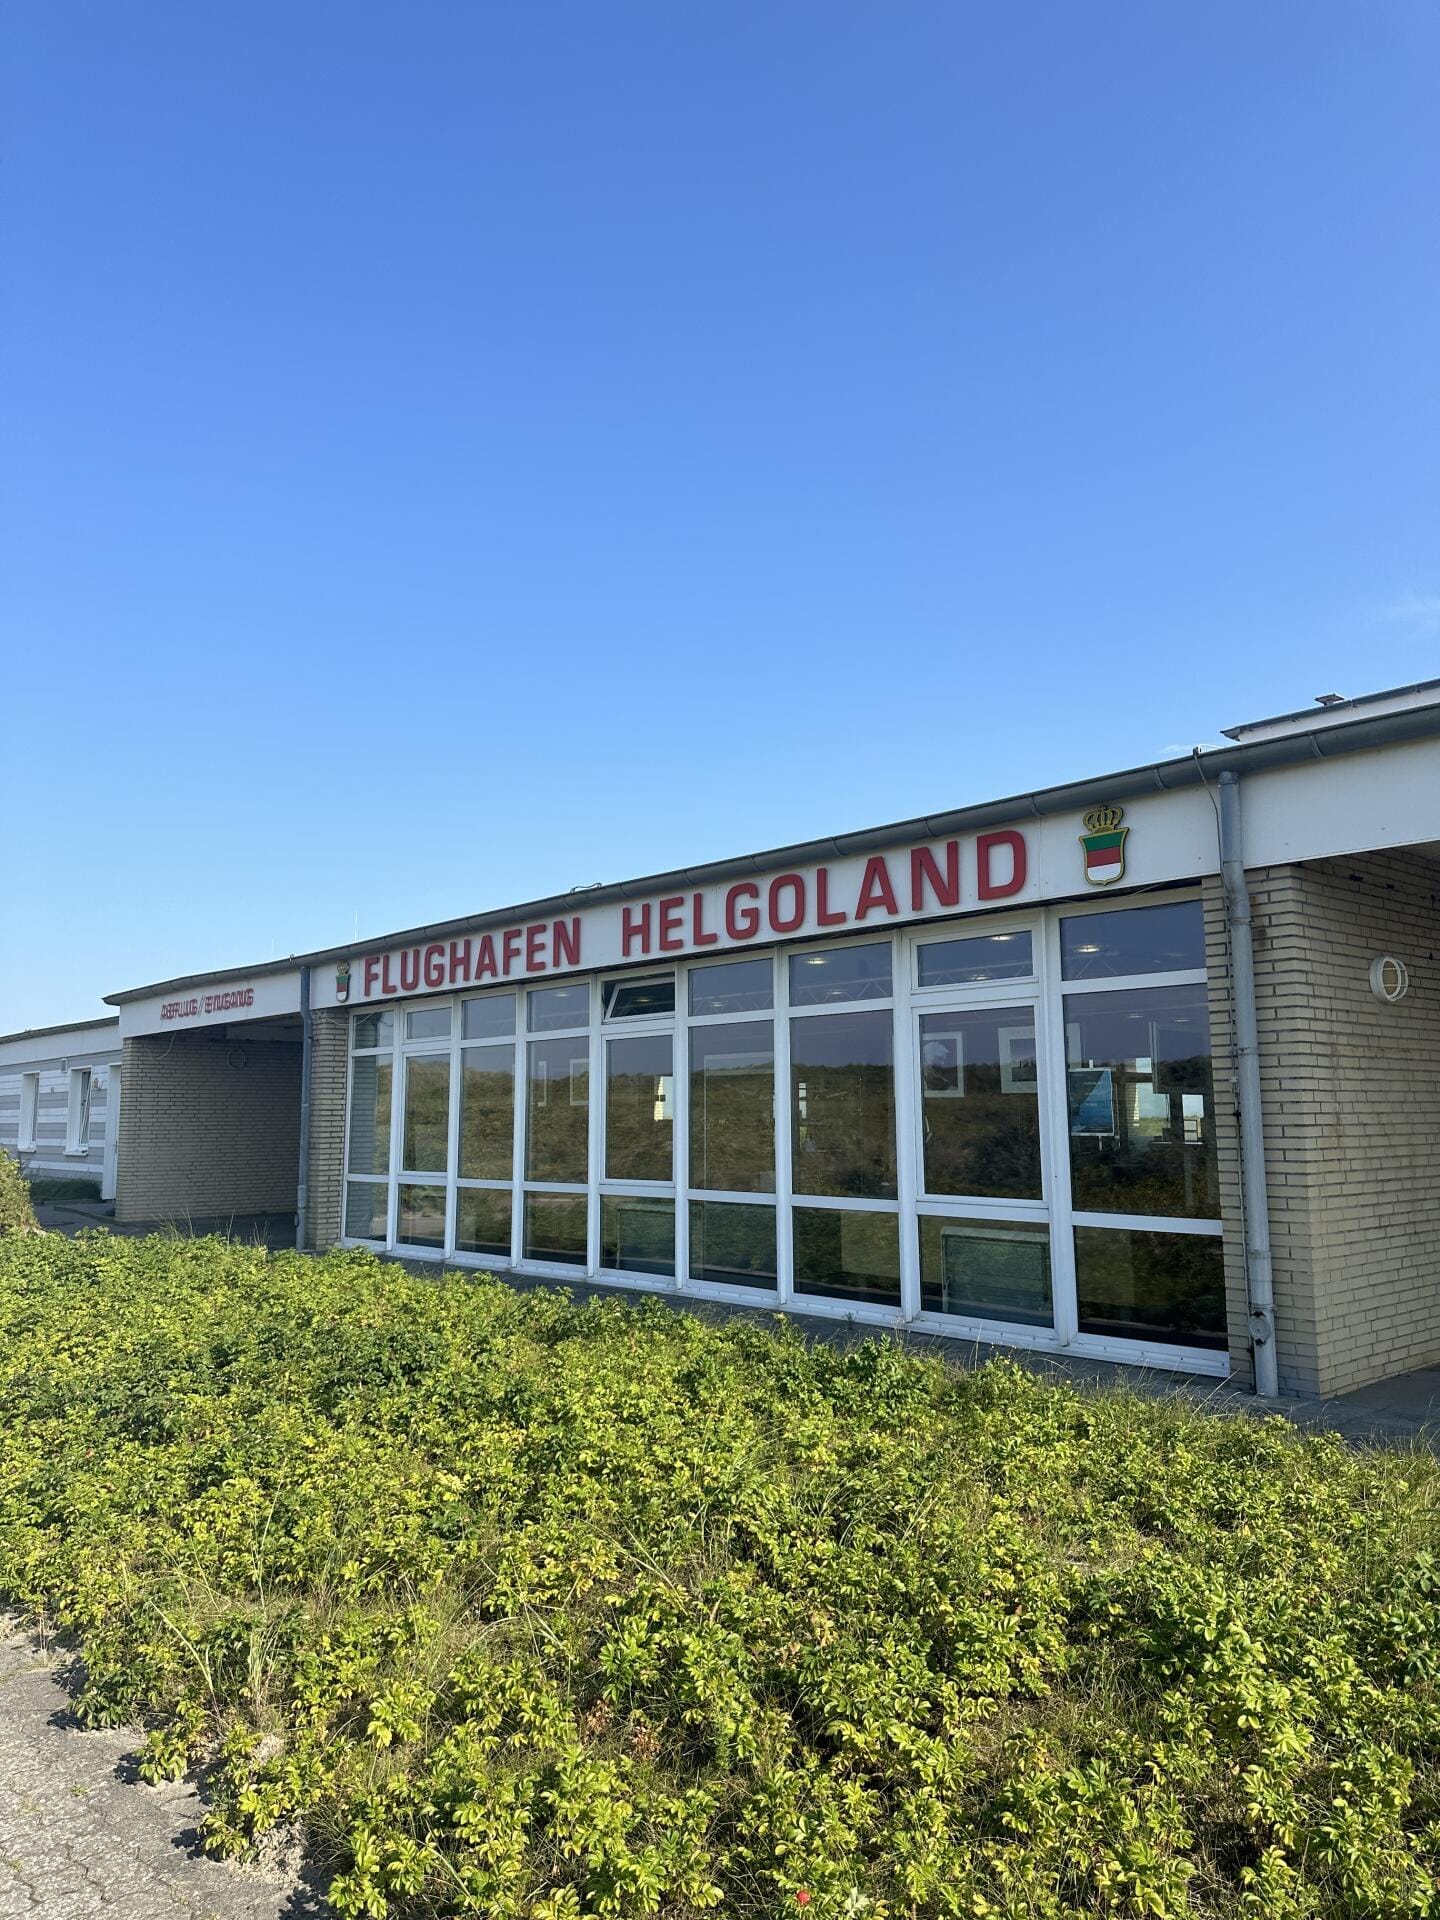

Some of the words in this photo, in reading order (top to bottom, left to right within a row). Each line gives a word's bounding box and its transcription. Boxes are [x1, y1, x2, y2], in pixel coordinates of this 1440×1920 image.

[364, 917, 581, 997] FLUGHAFEN
[621, 829, 1027, 957] HELGOLAND
[204, 988, 255, 1013] EINGANG
